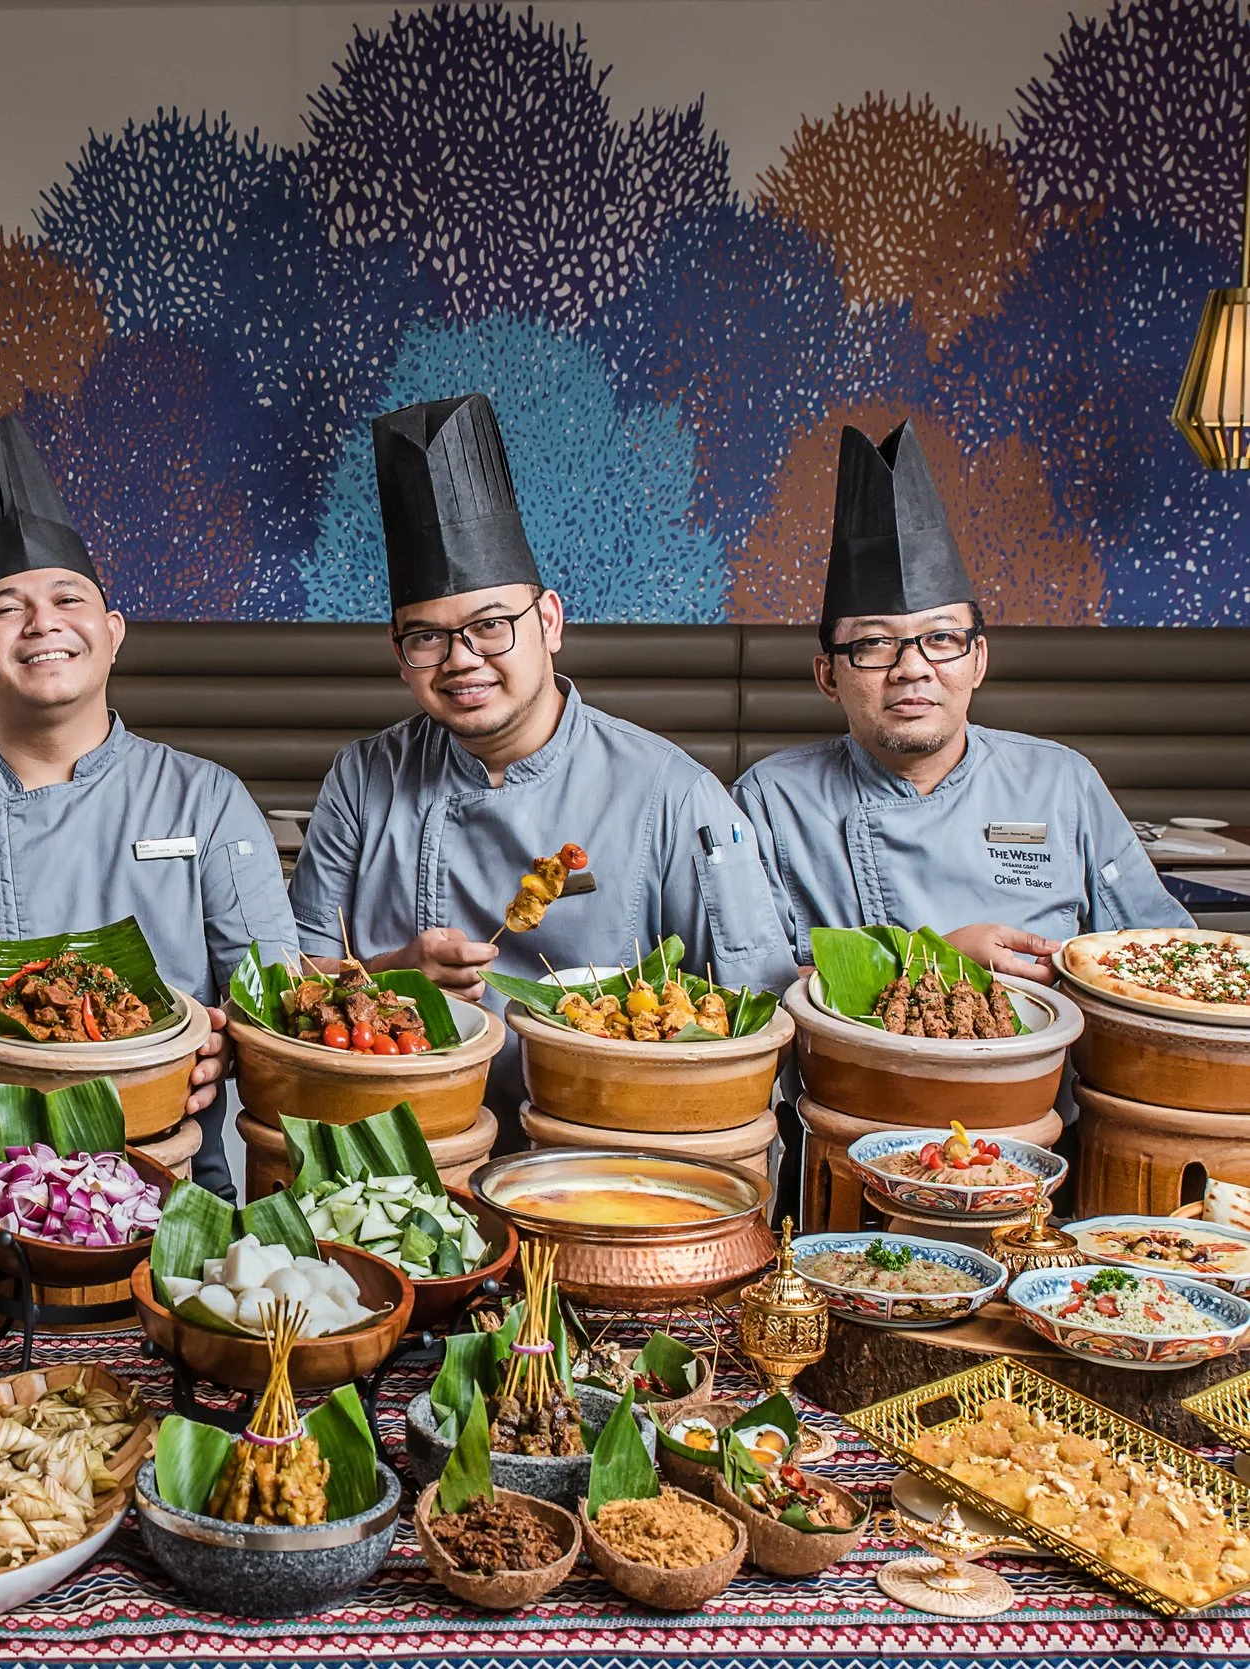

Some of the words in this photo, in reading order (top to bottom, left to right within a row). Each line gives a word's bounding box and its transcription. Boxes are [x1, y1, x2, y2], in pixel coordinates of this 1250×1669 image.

[987, 848, 1009, 859] THE
[1008, 849, 1051, 862] WESTIN
[994, 874, 1021, 885] Chief
[1025, 878, 1053, 889] Baker
